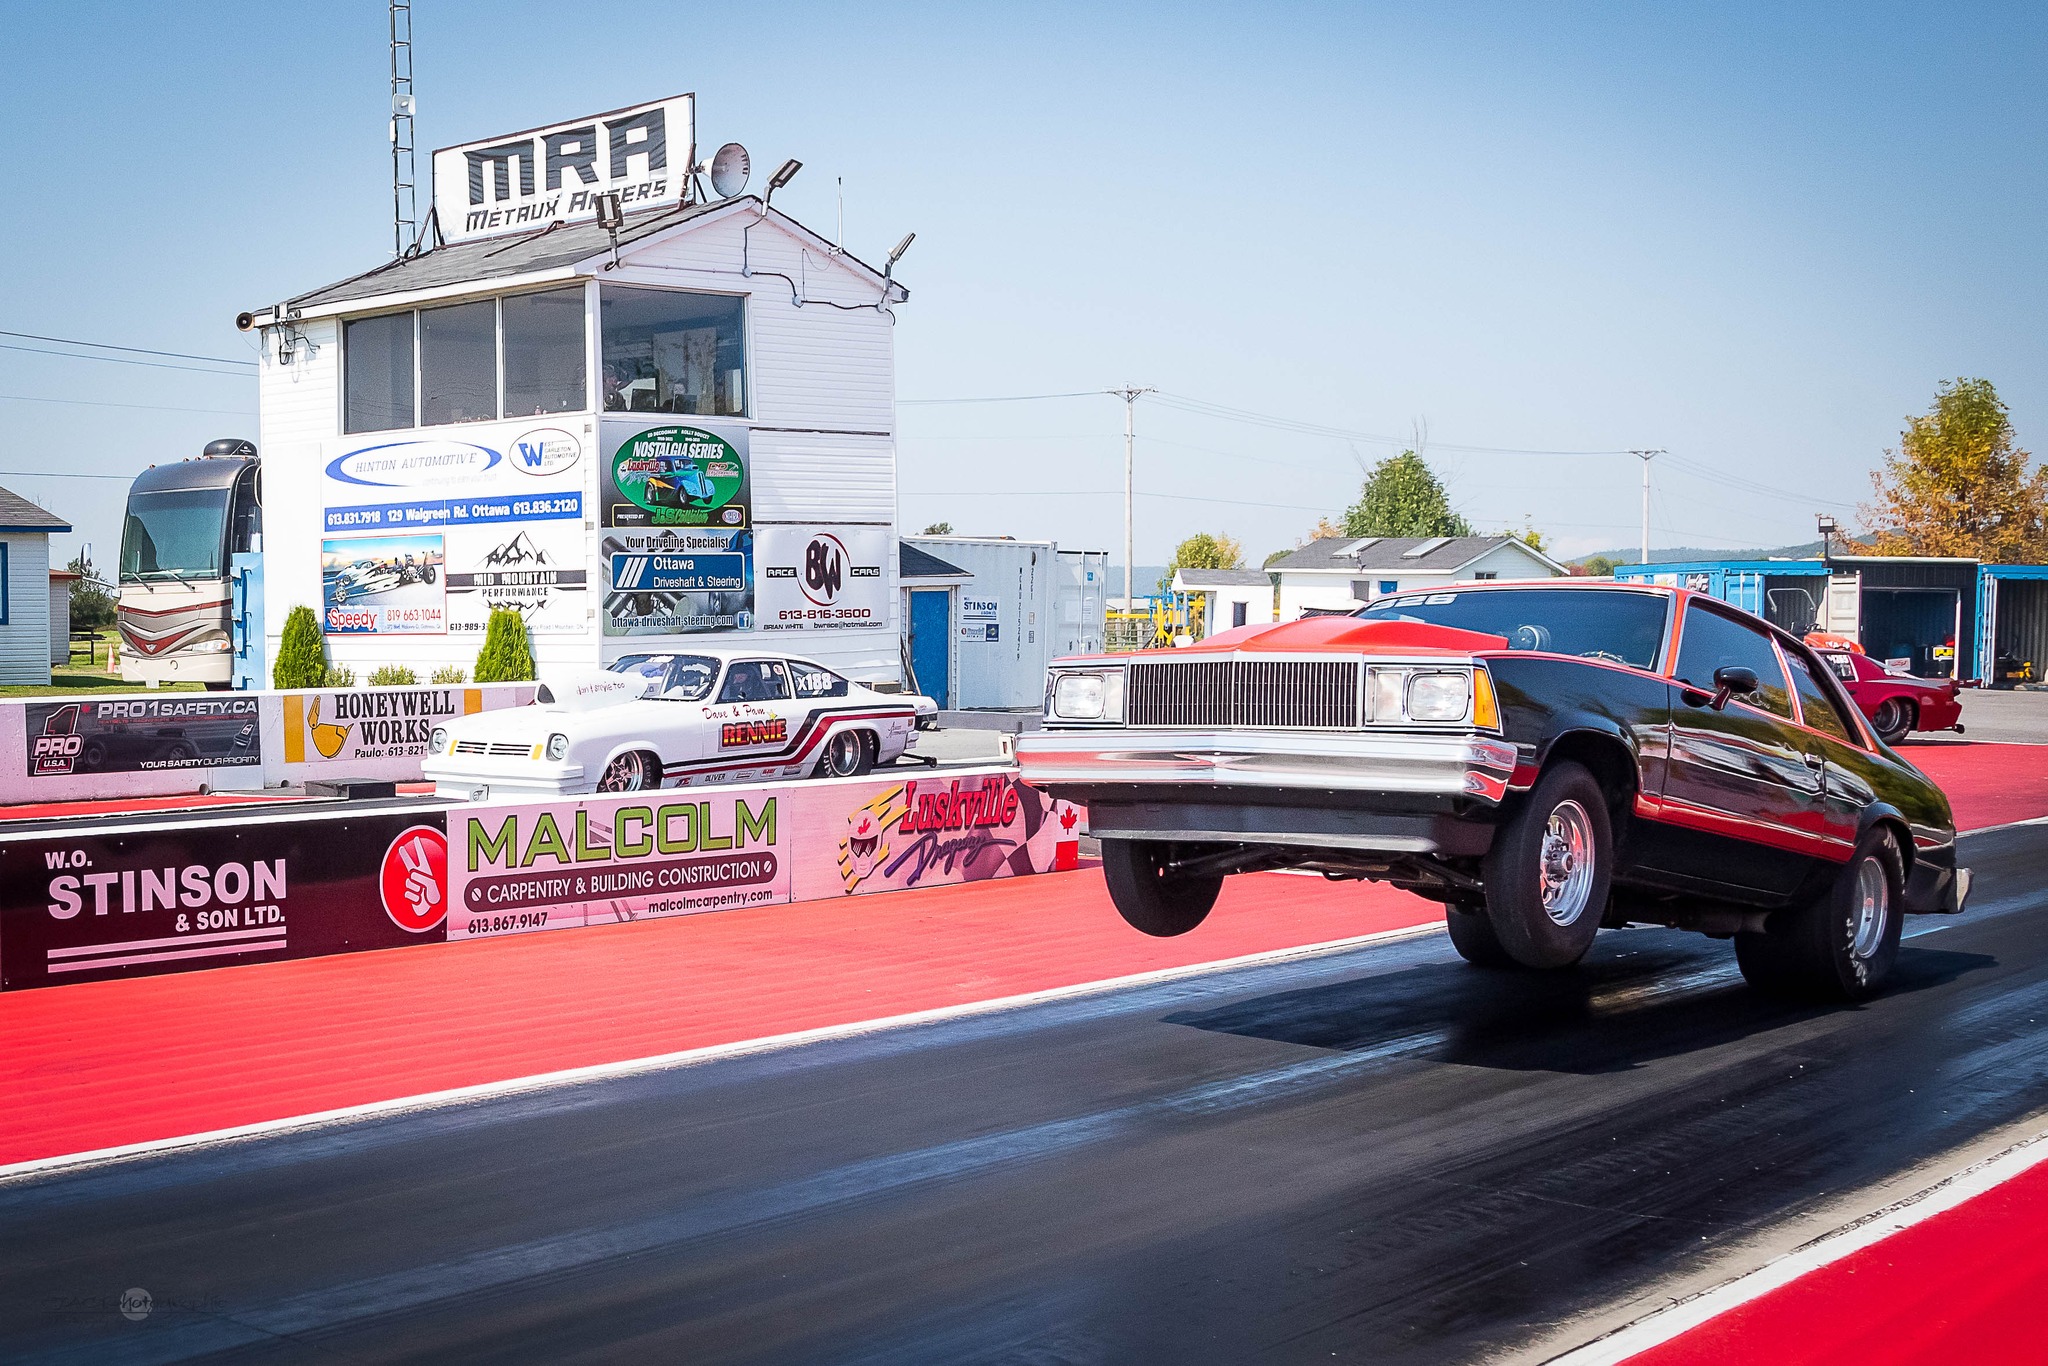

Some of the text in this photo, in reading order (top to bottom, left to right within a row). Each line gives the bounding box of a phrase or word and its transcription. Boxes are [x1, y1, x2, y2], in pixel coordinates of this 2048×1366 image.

[463, 107, 668, 205] MRA
[568, 180, 668, 213] ANERS
[632, 441, 724, 459] NOSTALGIA SERIES
[355, 452, 477, 473] HINTON AUTOMOTIVE
[328, 499, 578, 526] 613.831.7918 129 Walgreen Rd. Ottawa 613.836.2120
[626, 536, 729, 549] Your Driveline Specialist
[653, 556, 694, 570] Ottawa
[767, 568, 880, 577] RACE CARS
[473, 571, 558, 585] MID MOUNTAIN
[653, 576, 740, 588] Driveshaft & Steering
[482, 587, 548, 597] PERFORMANCE
[327, 609, 377, 630] Speedy
[387, 608, 441, 621] 819 663-1044
[612, 614, 733, 628] ottawa-driveshaft-steering.com
[779, 609, 871, 620] 613-816-3600
[334, 691, 455, 719] HONEYWELL
[702, 704, 765, 720] Dave & Pam
[359, 718, 430, 745] WORKS
[722, 718, 787, 747] RENNIE
[34, 736, 81, 756] PRO
[355, 748, 385, 758] Paulo:
[43, 759, 66, 767] U.S.A.
[139, 754, 259, 769] YOUR SAFETY OUR PRIORITY
[705, 774, 725, 782] OLIVER
[899, 777, 1018, 833] Luskville
[467, 797, 778, 873] MALCOLM
[45, 850, 93, 870] W.O.
[884, 832, 1017, 886] Dragway
[47, 859, 287, 920] STINSON
[487, 860, 760, 905] CARPENTRY & BUILDING CONSTRUCTION
[648, 889, 773, 913] malcolmcarpentry.com
[175, 905, 286, 932] & SON LTD.
[467, 912, 548, 935] 613.867.9147
